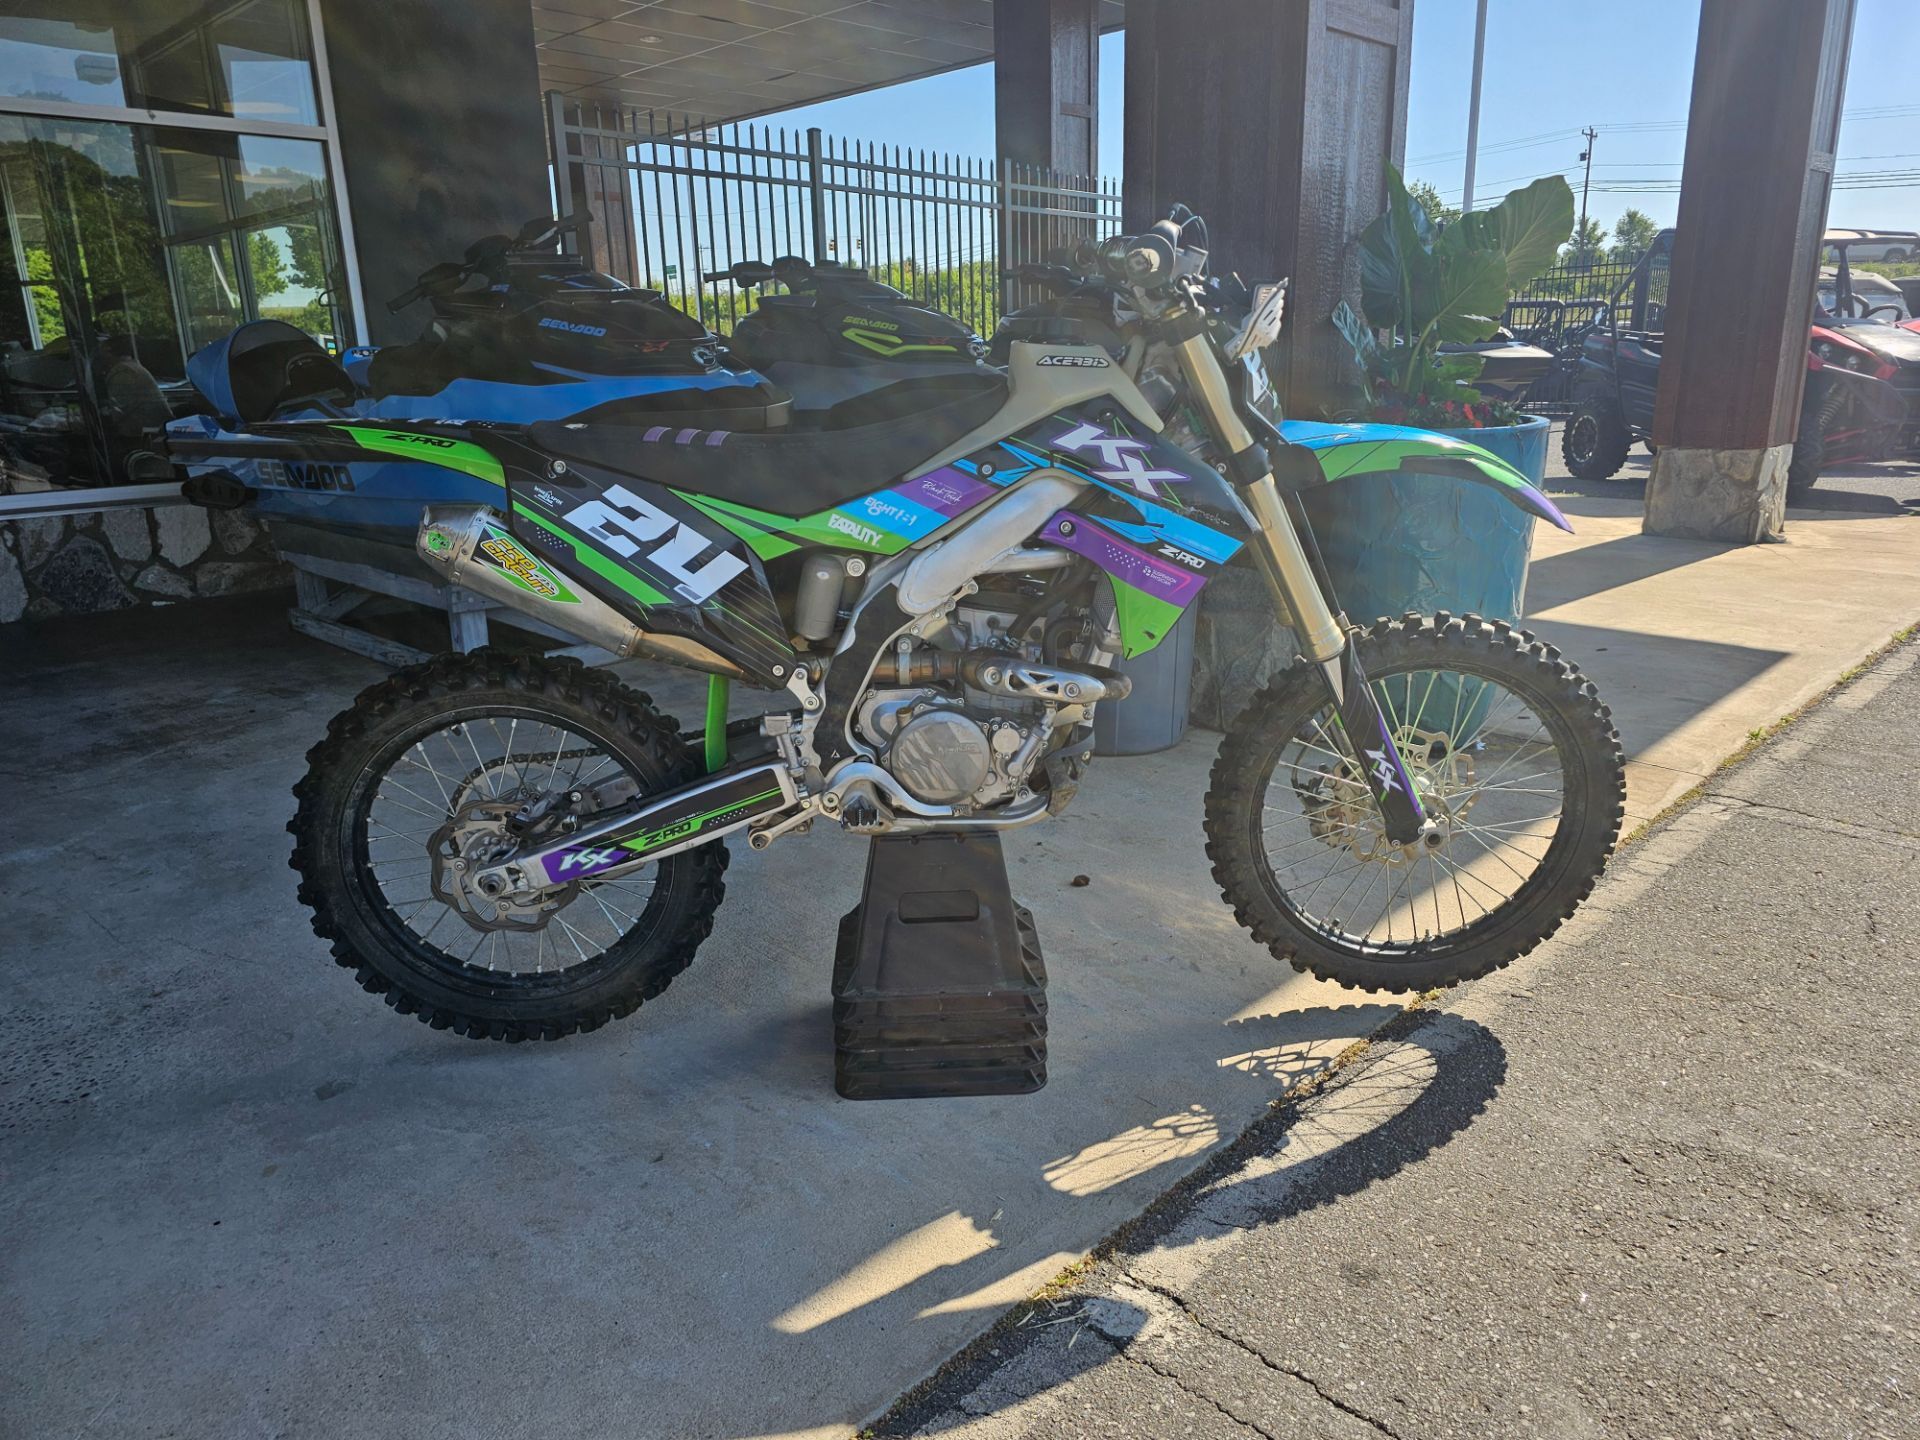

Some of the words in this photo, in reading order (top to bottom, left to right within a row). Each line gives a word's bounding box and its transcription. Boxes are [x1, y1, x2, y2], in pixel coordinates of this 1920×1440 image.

[1037, 355, 1110, 368] ACERBIS
[1050, 421, 1190, 499] KX
[828, 513, 884, 547] FATALITY
[481, 541, 556, 596] CIRCUIT
[495, 539, 538, 571] PRO
